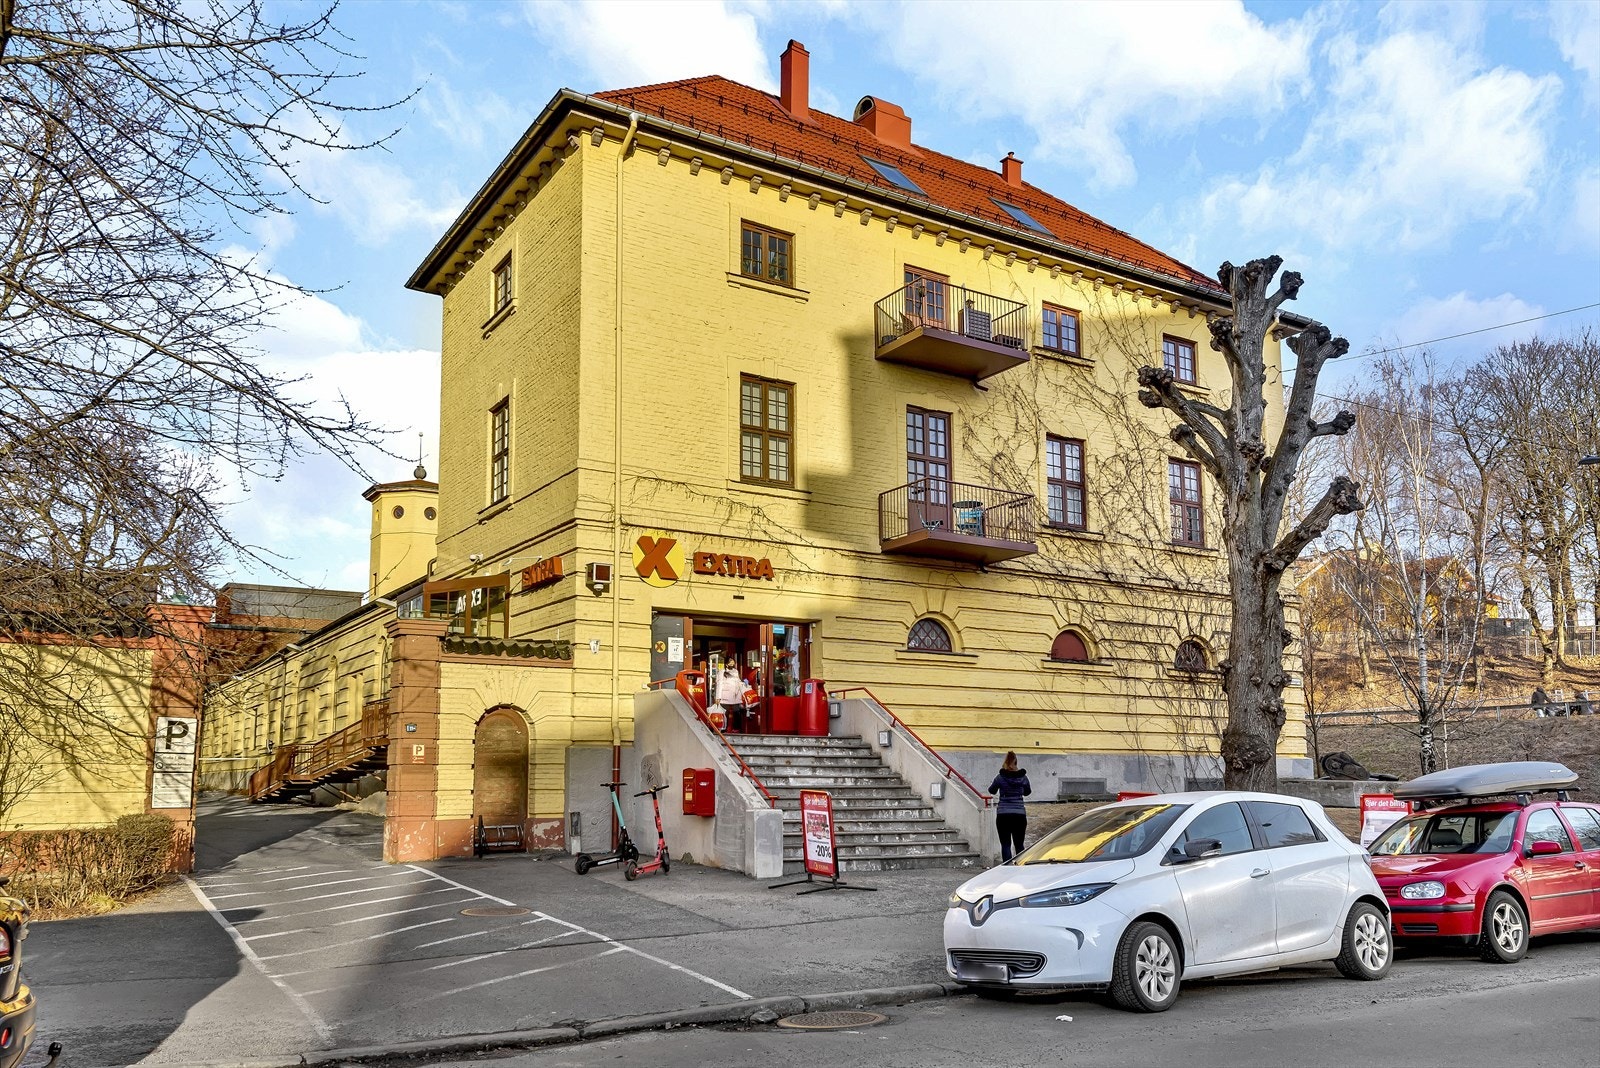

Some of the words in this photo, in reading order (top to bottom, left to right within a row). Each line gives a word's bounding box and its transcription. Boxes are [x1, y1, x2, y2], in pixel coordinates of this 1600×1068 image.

[693, 551, 775, 581] EXTRA
[165, 720, 189, 749] P
[415, 745, 422, 754] P
[815, 844, 832, 858] -20%
